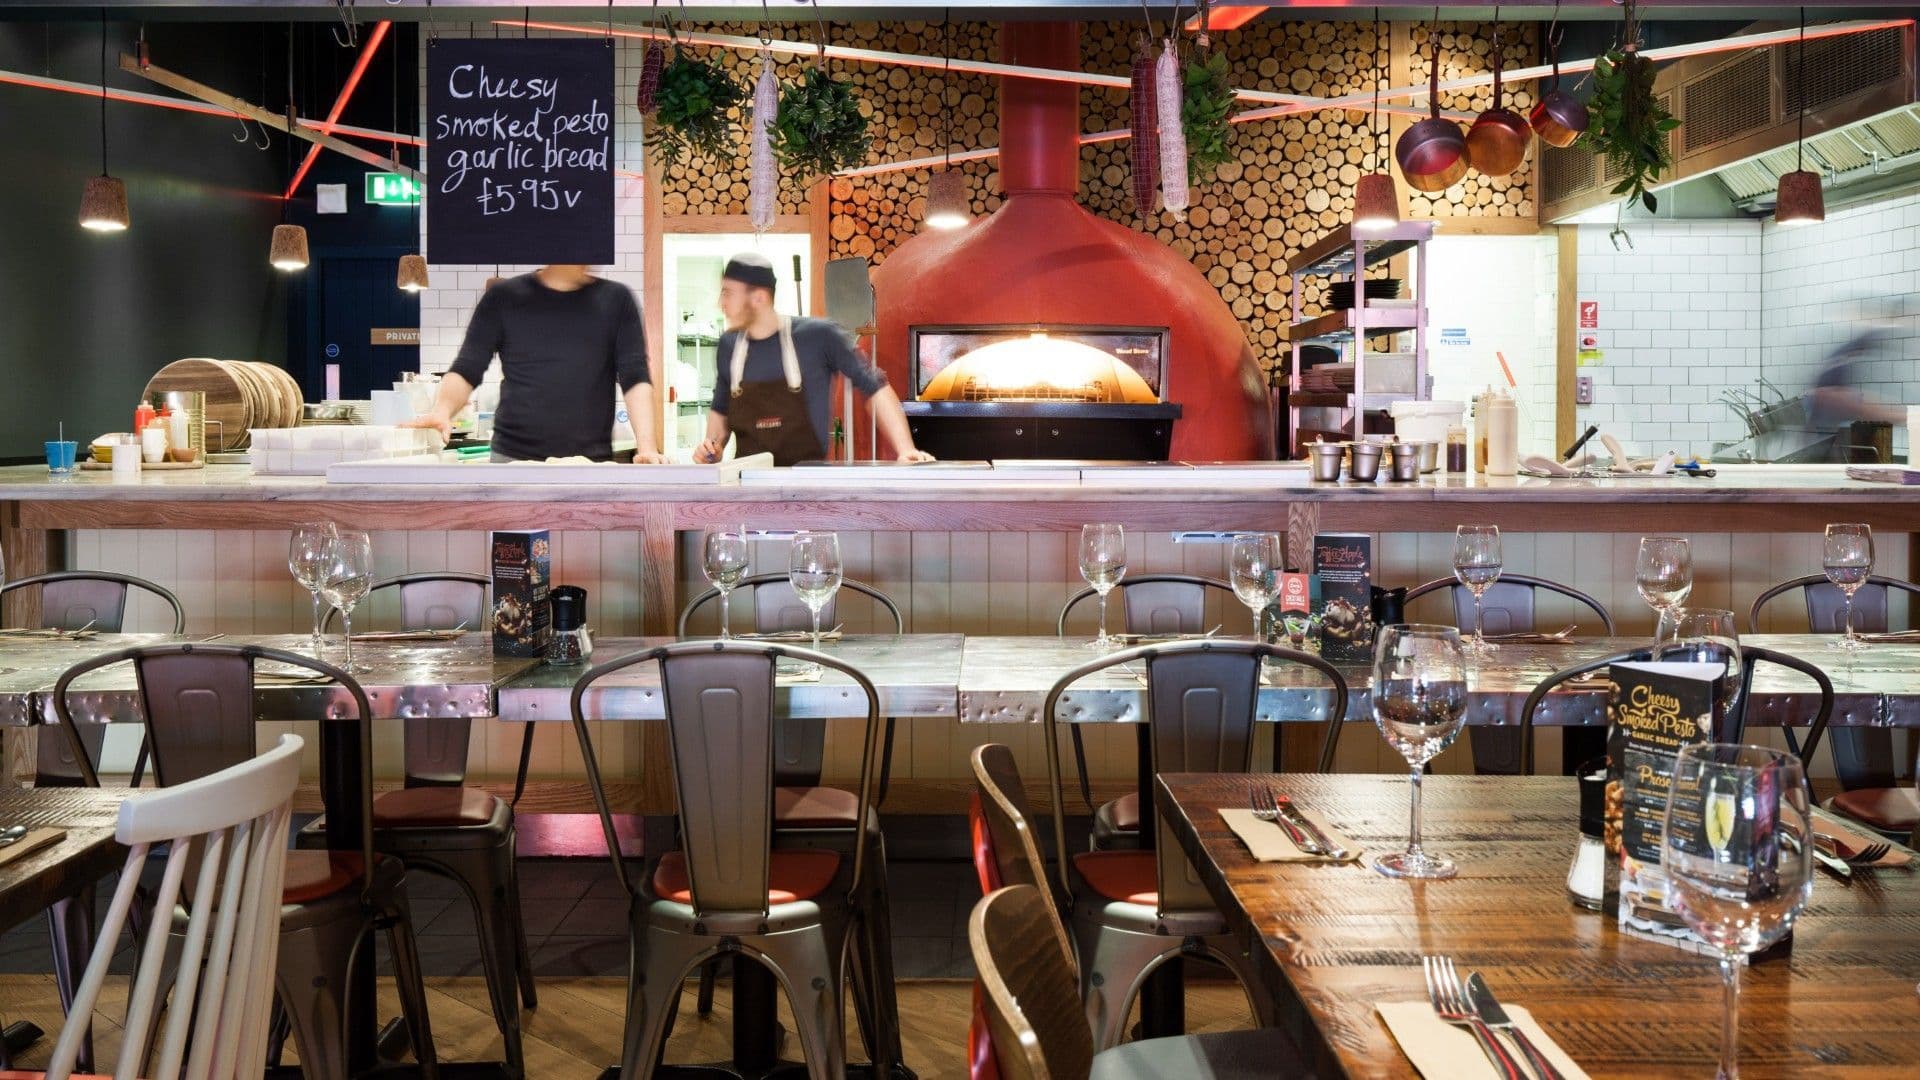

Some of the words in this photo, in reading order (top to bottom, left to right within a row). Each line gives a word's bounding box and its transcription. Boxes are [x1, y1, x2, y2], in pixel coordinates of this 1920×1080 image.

[450, 64, 559, 113] Cheesy
[436, 107, 544, 142] smoked
[552, 99, 609, 151] pesto
[441, 140, 535, 193] garlic
[541, 136, 609, 173] bread
[1631, 685, 1680, 715] Cheesy
[1618, 704, 1660, 731] Smoked
[1660, 713, 1696, 738] Pesto
[1632, 731, 1655, 742] GARLIC
[1656, 736, 1679, 747] BREAD
